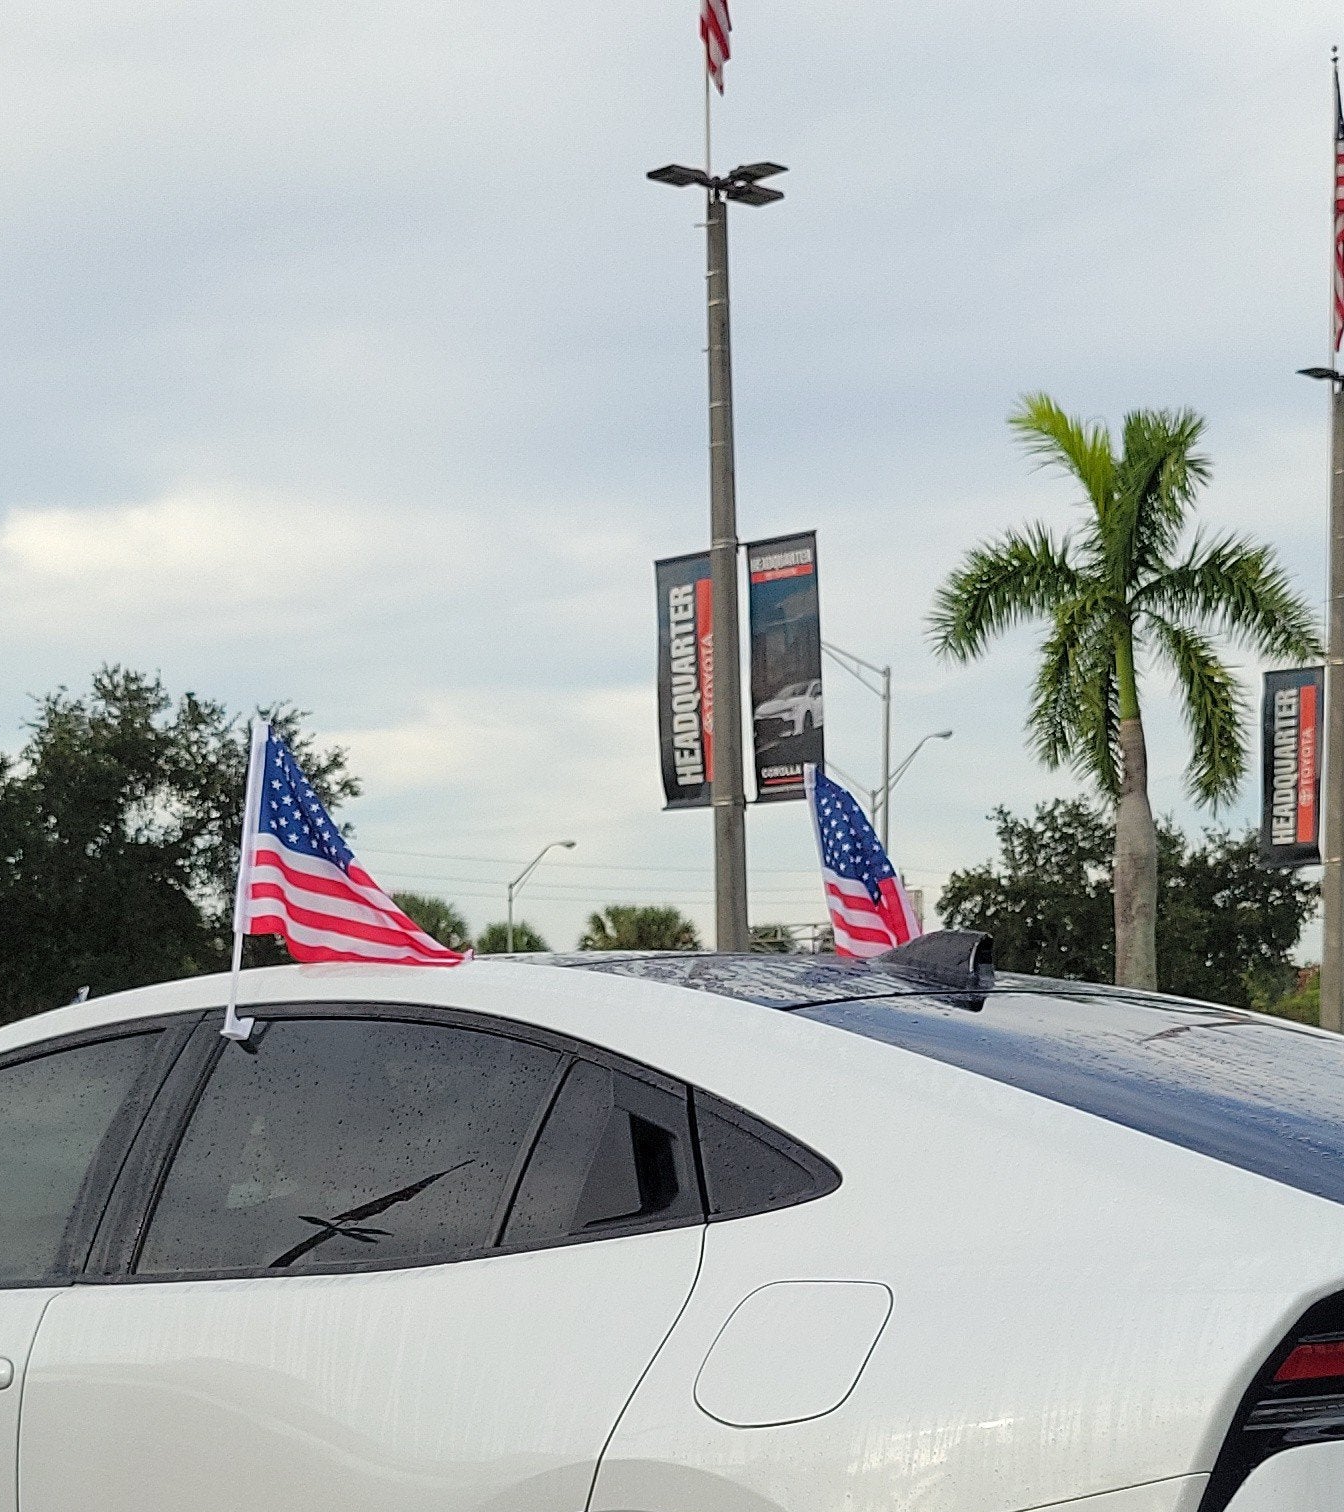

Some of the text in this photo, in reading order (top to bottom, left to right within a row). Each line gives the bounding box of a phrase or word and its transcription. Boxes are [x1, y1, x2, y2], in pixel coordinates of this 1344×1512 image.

[669, 583, 704, 786] HEADQUARTER
[1300, 728, 1314, 785] TOYOTA
[1272, 688, 1299, 846] HEADQUARTER
